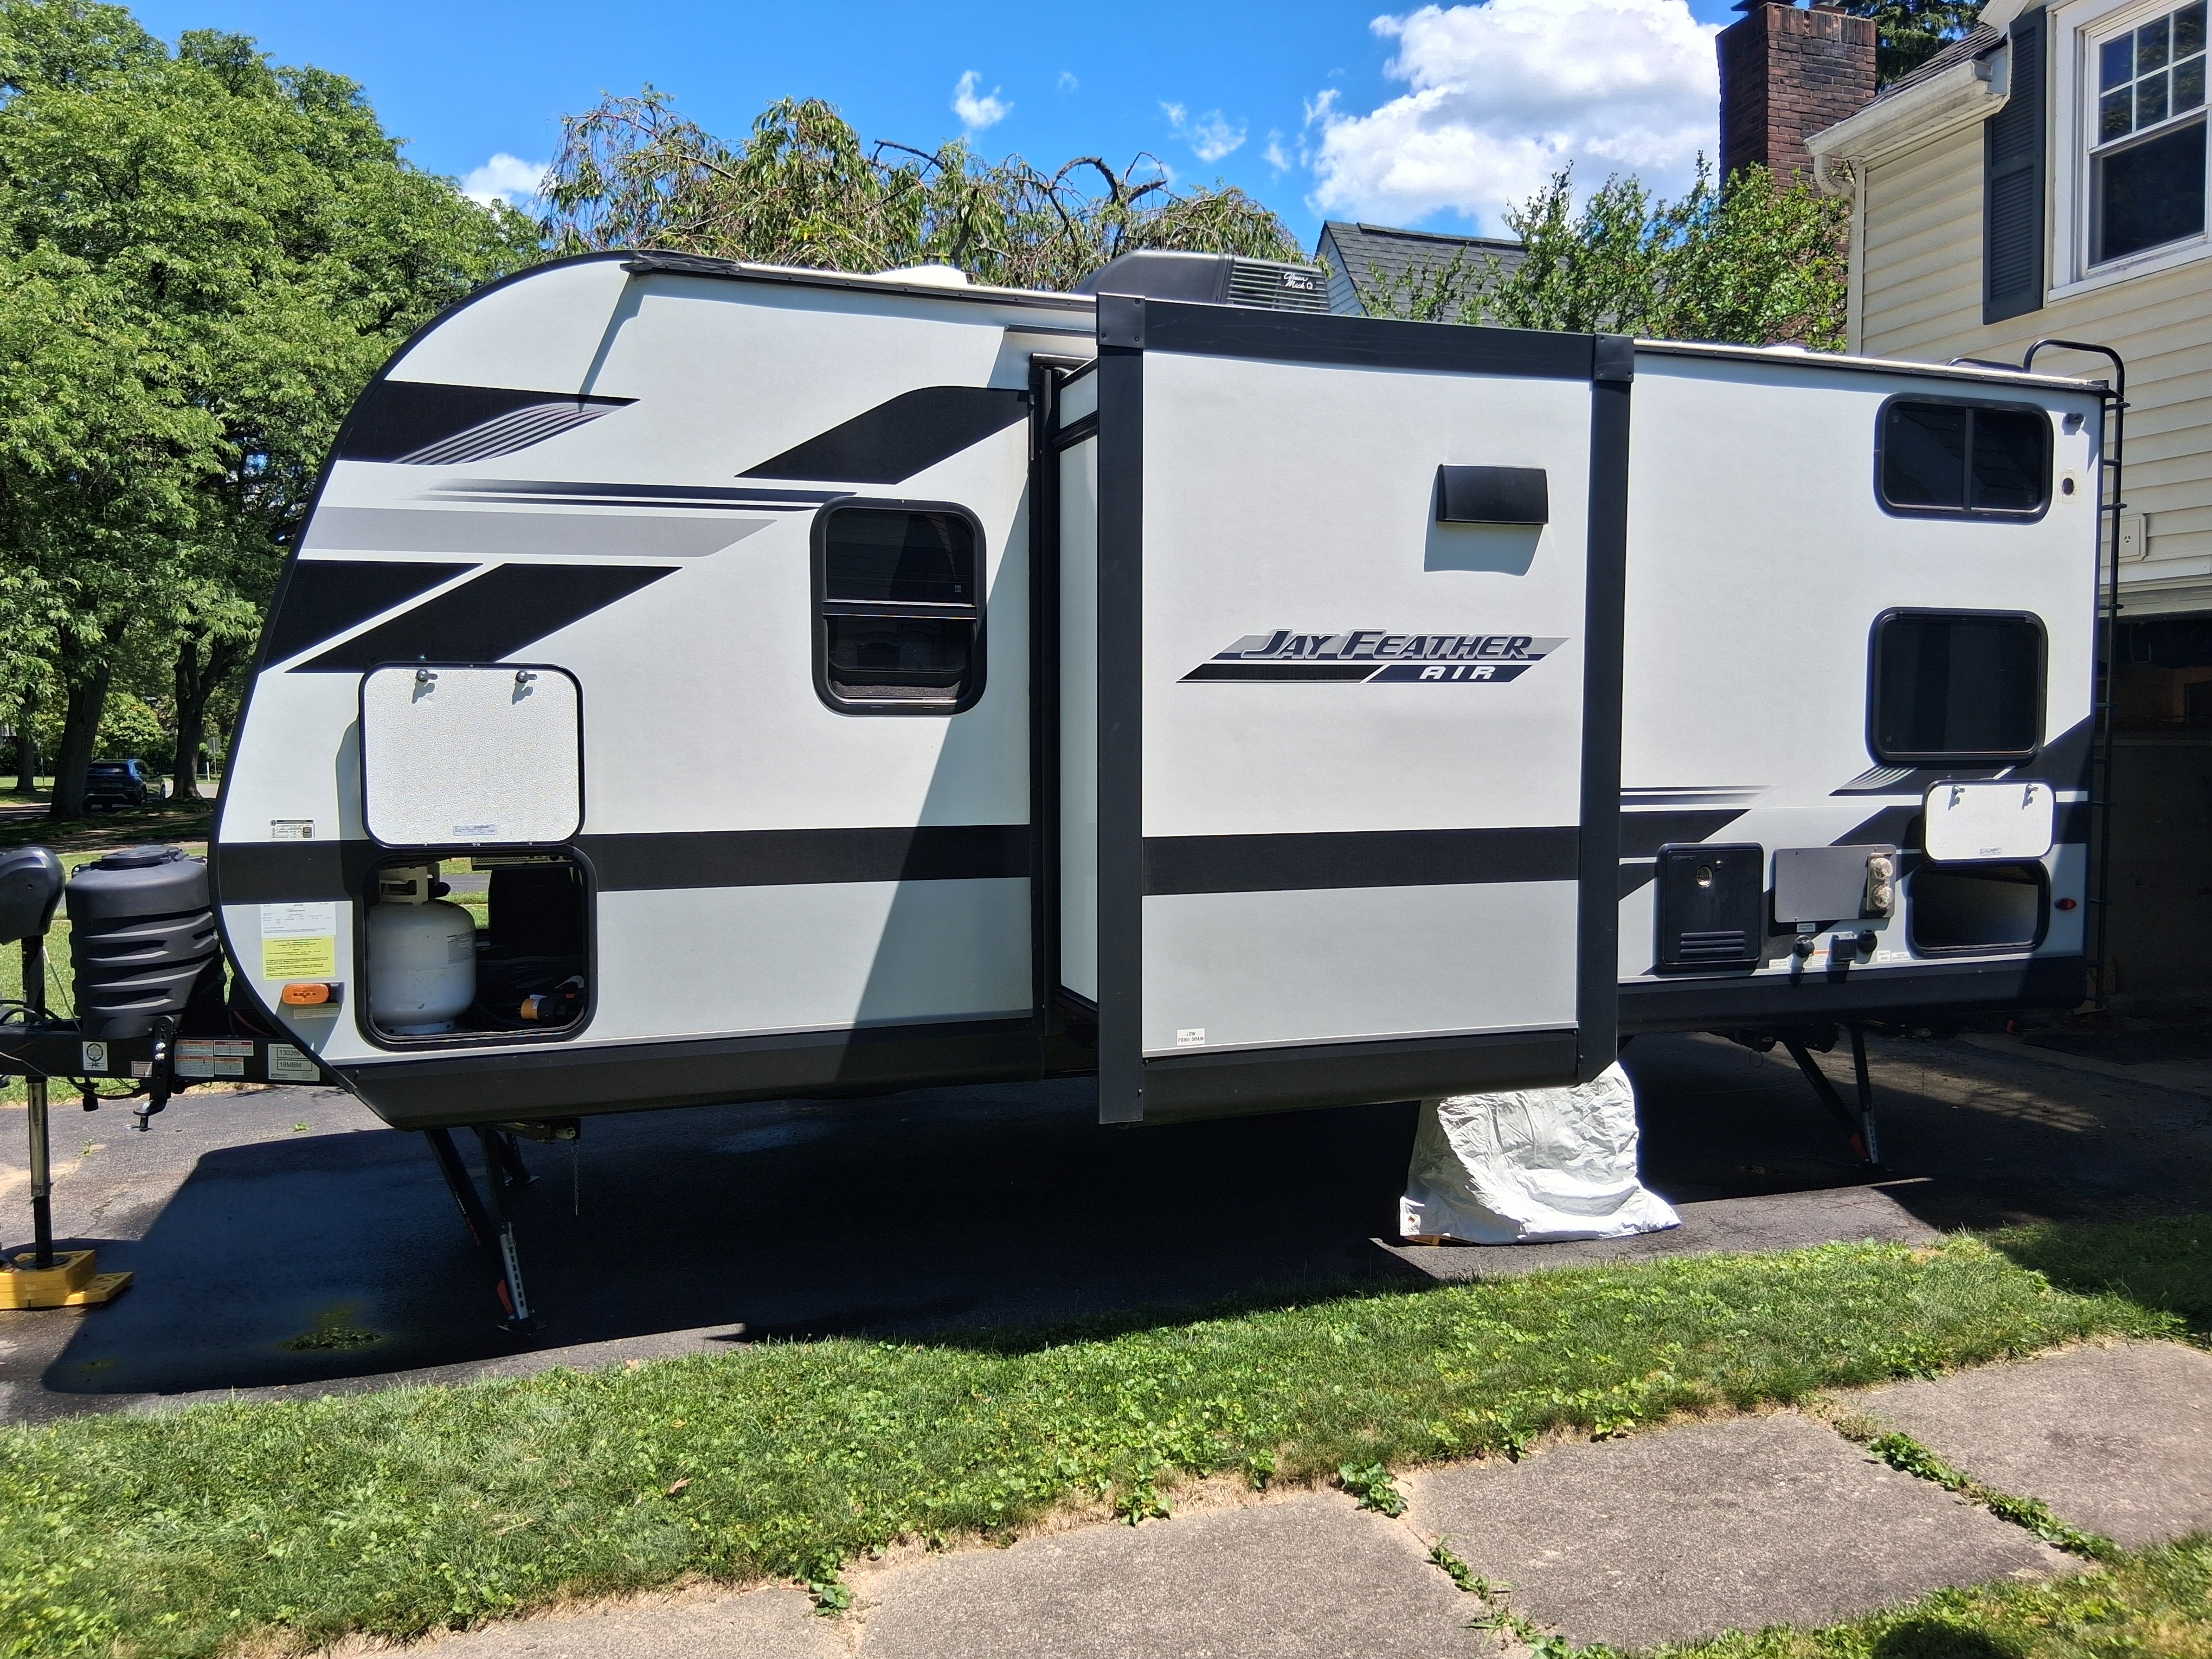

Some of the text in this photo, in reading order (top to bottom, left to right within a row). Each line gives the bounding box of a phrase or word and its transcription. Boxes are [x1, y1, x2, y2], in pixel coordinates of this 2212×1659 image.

[1307, 281, 1313, 290] Q
[1242, 628, 1533, 659] JAY FEATHER
[1419, 665, 1496, 680] AIR
